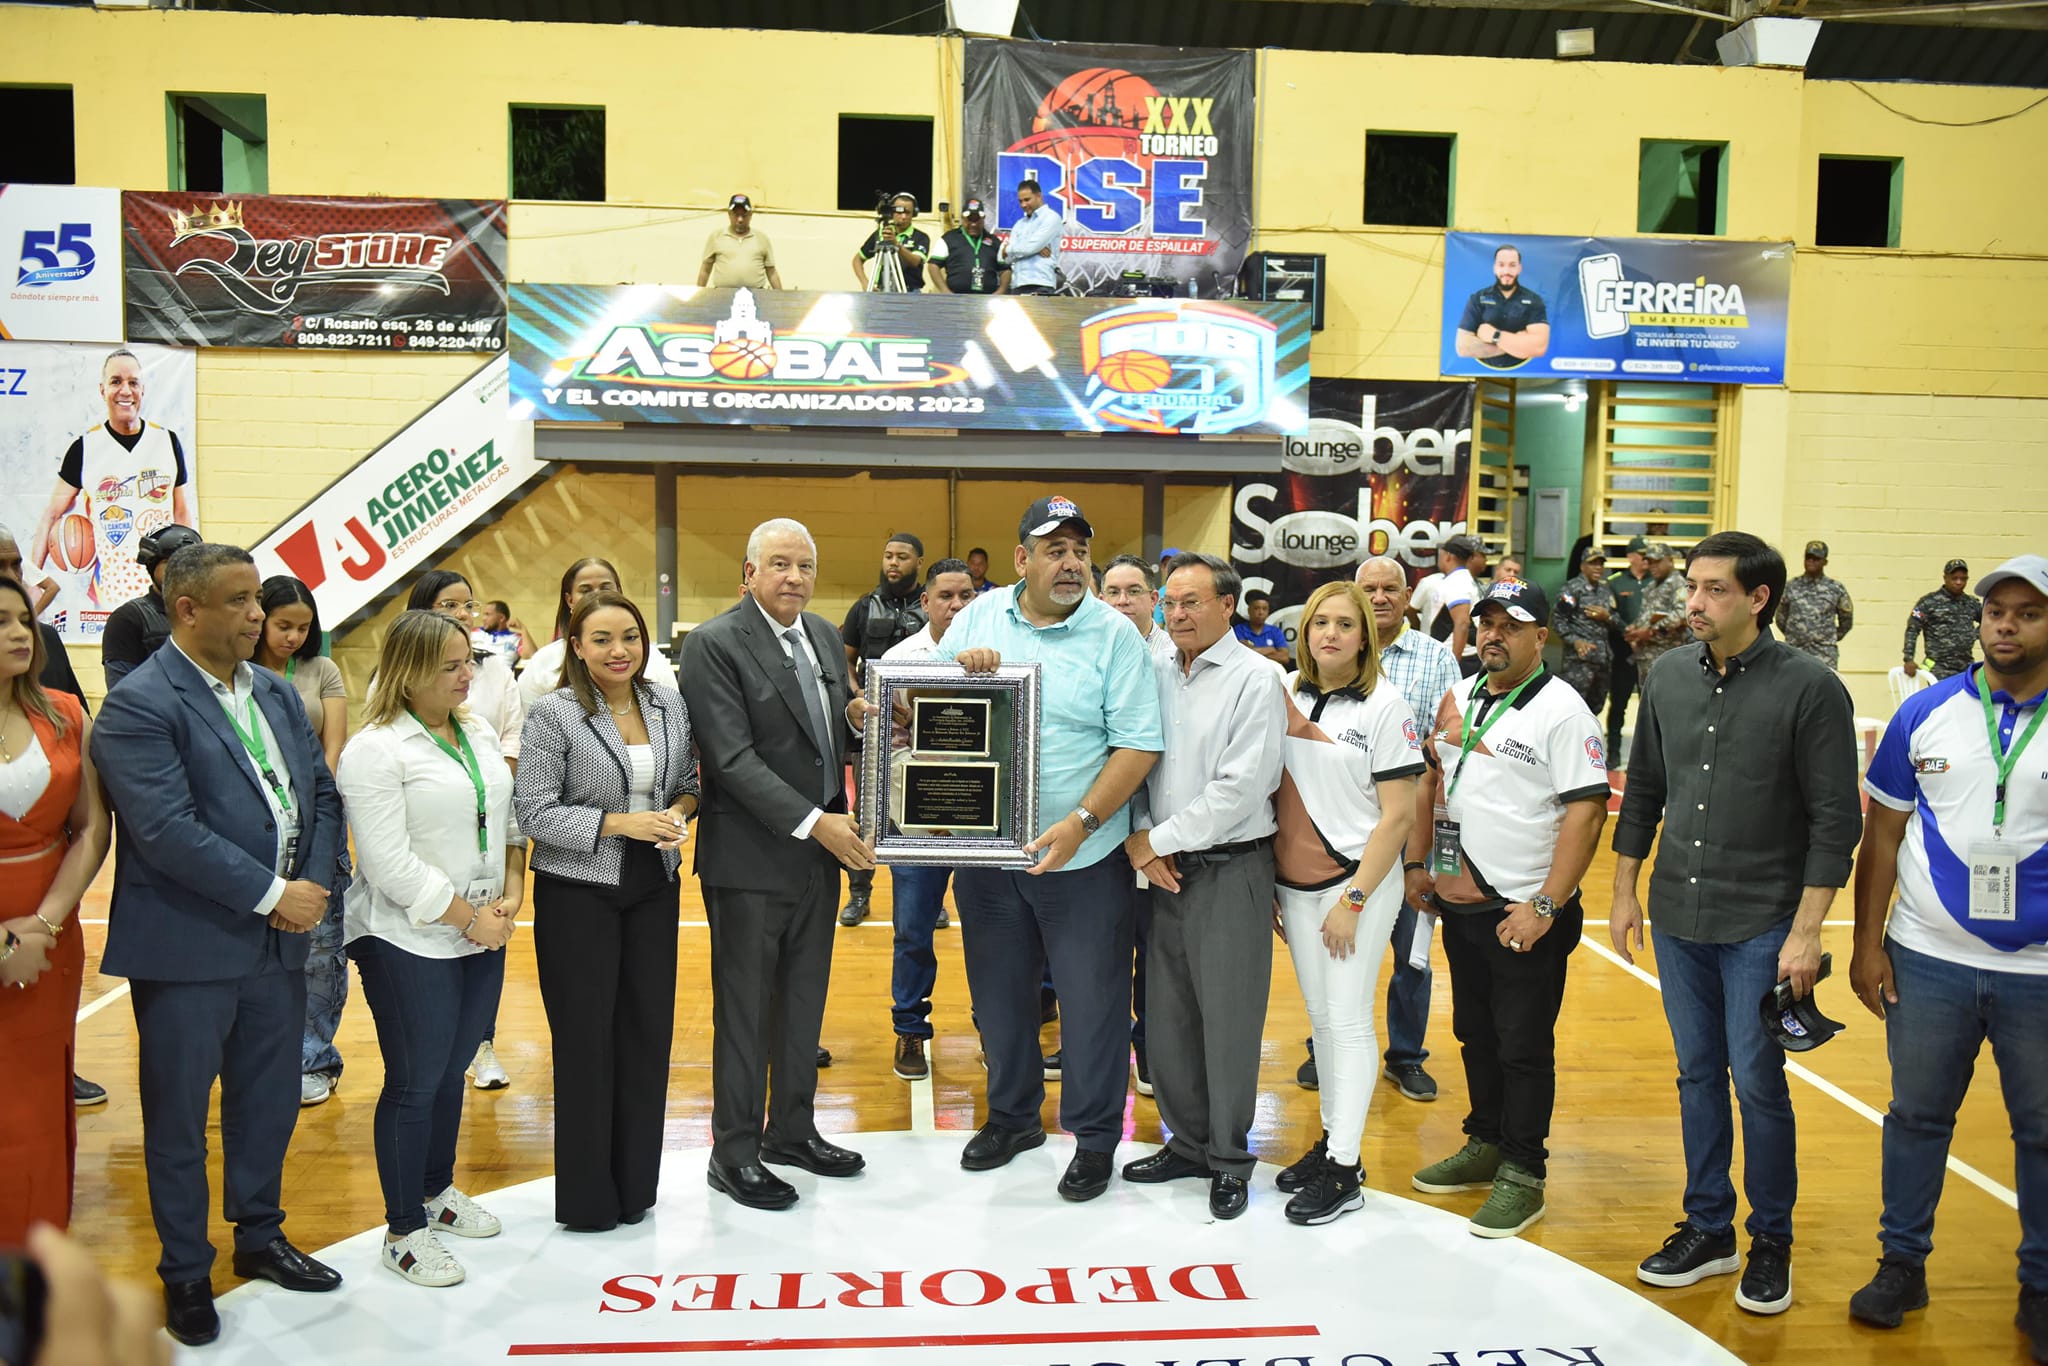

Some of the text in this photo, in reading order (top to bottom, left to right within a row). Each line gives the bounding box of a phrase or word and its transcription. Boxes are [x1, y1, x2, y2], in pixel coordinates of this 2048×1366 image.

[1144, 96, 1215, 136] XXX
[1140, 133, 1219, 157] TORNEO
[996, 151, 1208, 238] BSE
[18, 222, 96, 287] 55
[314, 232, 453, 272] STORE
[1070, 237, 1127, 250] SUPERIOR
[1129, 240, 1146, 251] DE
[1147, 240, 1205, 254] ESPAILLAT
[35, 268, 86, 280] Aniversario
[48, 293, 80, 302] siempre
[305, 317, 492, 333] C/ Rosario esq. 26 de Julio
[1639, 315, 1736, 326] SMARTPHONE
[298, 333, 391, 346] 809-823-7211
[409, 336, 501, 349] 849-220-4710
[1636, 338, 1649, 347] DE
[1649, 338, 1689, 348] INVERTIR
[1690, 339, 1702, 348] TU
[542, 388, 985, 414] Y EL COMITE ORGANIZADOR 2023
[1285, 436, 1361, 462] lounge
[366, 448, 450, 527] ACERO
[382, 438, 504, 549] JIMENEZ
[391, 463, 510, 559] ESTRUCTURAS METALICAS
[1281, 529, 1357, 555] lounge
[81, 611, 111, 621] SÍGUEN
[1346, 728, 1368, 742] COMIT
[1495, 743, 1537, 766] EJECUTIVO
[597, 1262, 1260, 1314] DEPORTES
